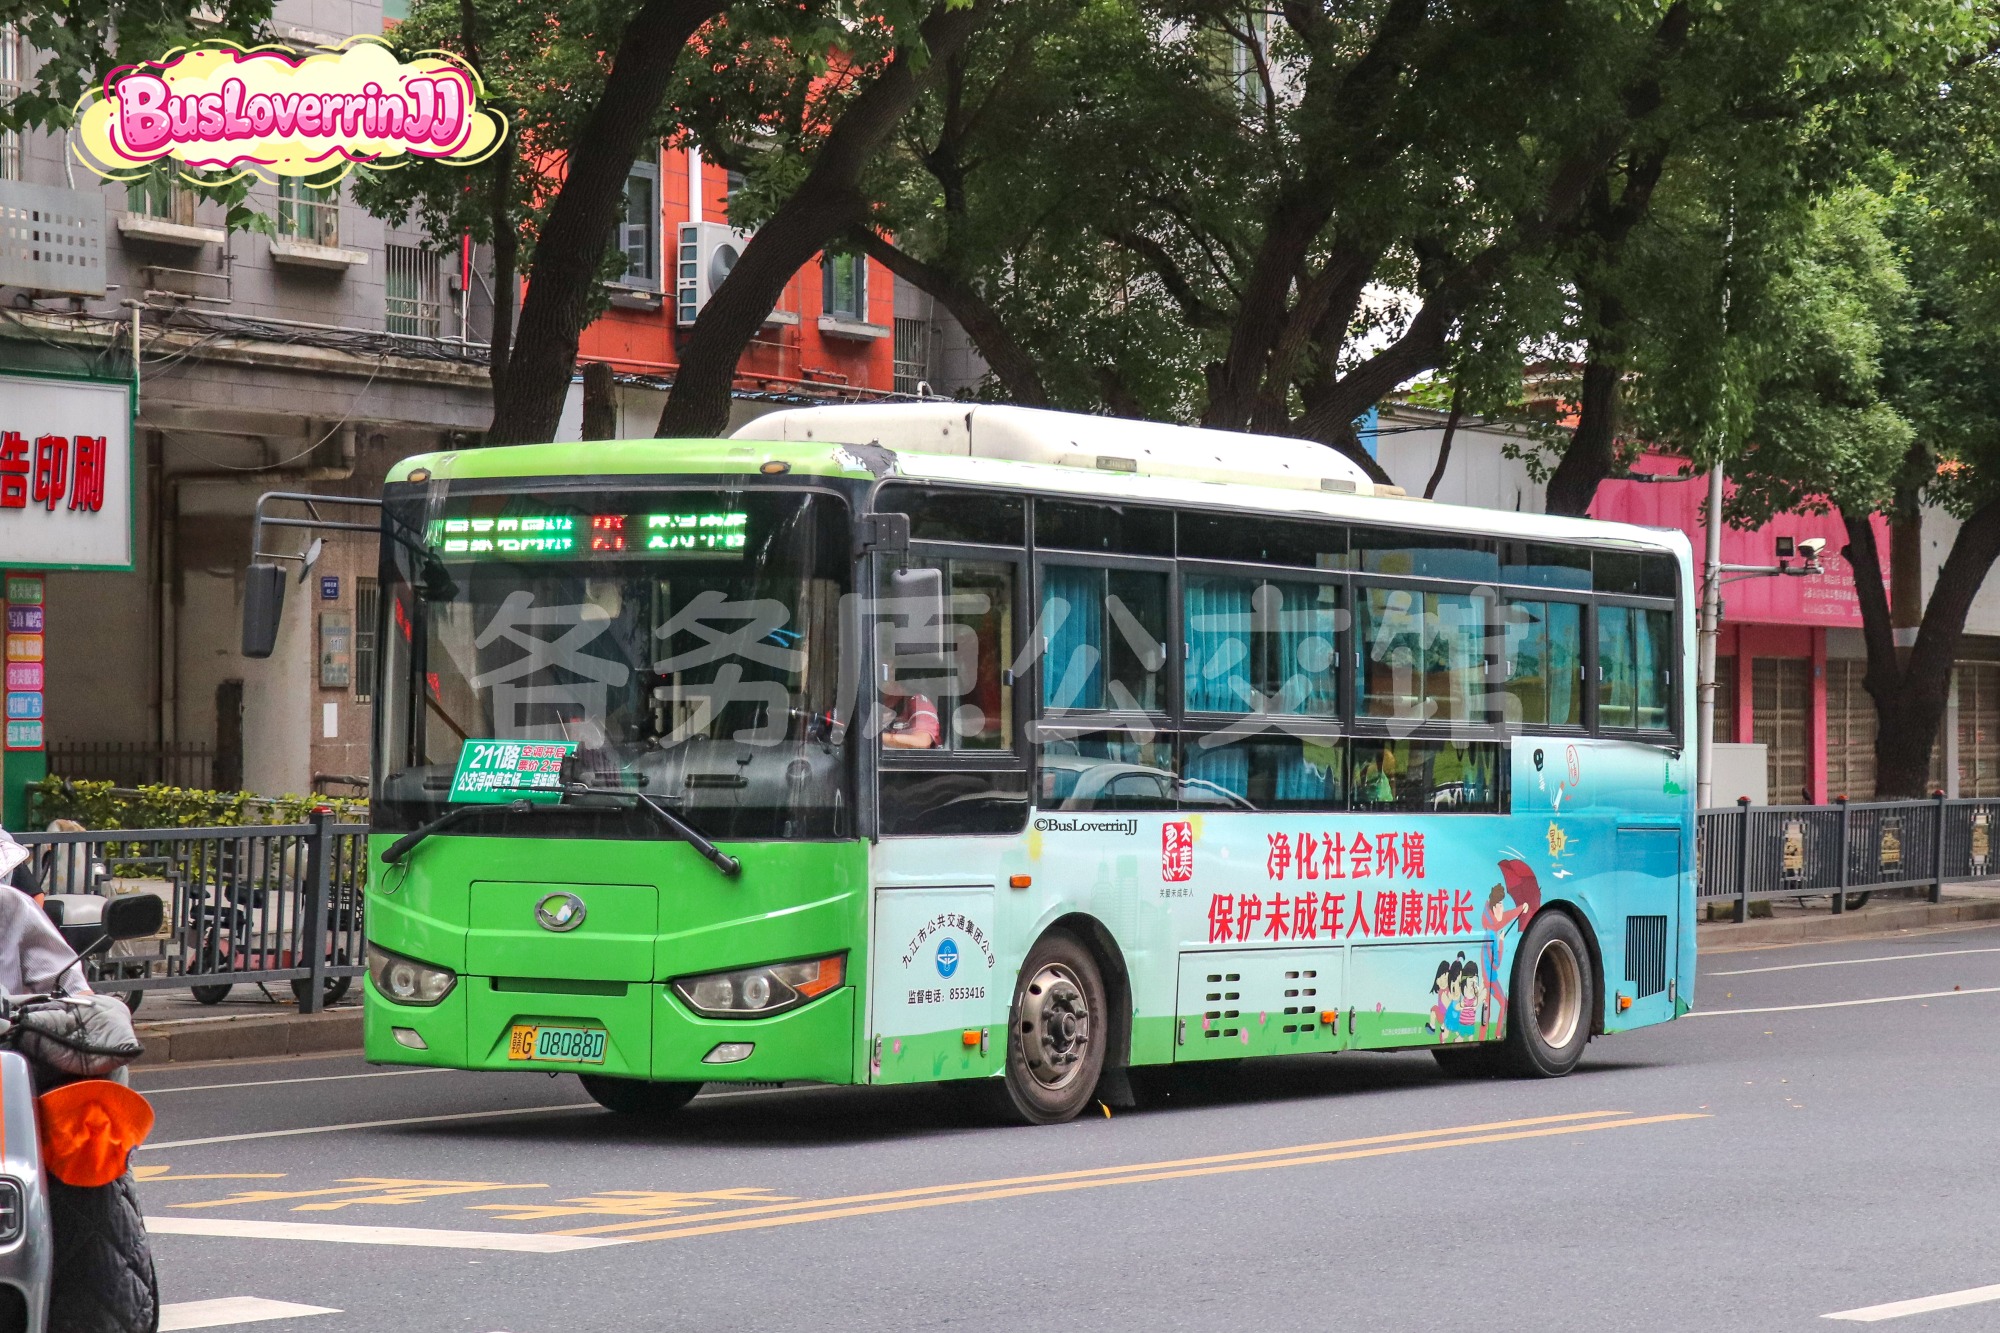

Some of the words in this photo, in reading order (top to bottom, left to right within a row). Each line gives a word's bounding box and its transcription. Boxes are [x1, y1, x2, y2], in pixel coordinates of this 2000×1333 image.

[0, 430, 107, 512] 告印刷
[469, 744, 521, 770] 211路
[521, 745, 566, 758] 空调开启
[1266, 831, 1425, 881] 净化社会环境
[901, 911, 996, 969] 九江市公共交通集团公司
[1207, 888, 1474, 944] 保护未成年人健康成长
